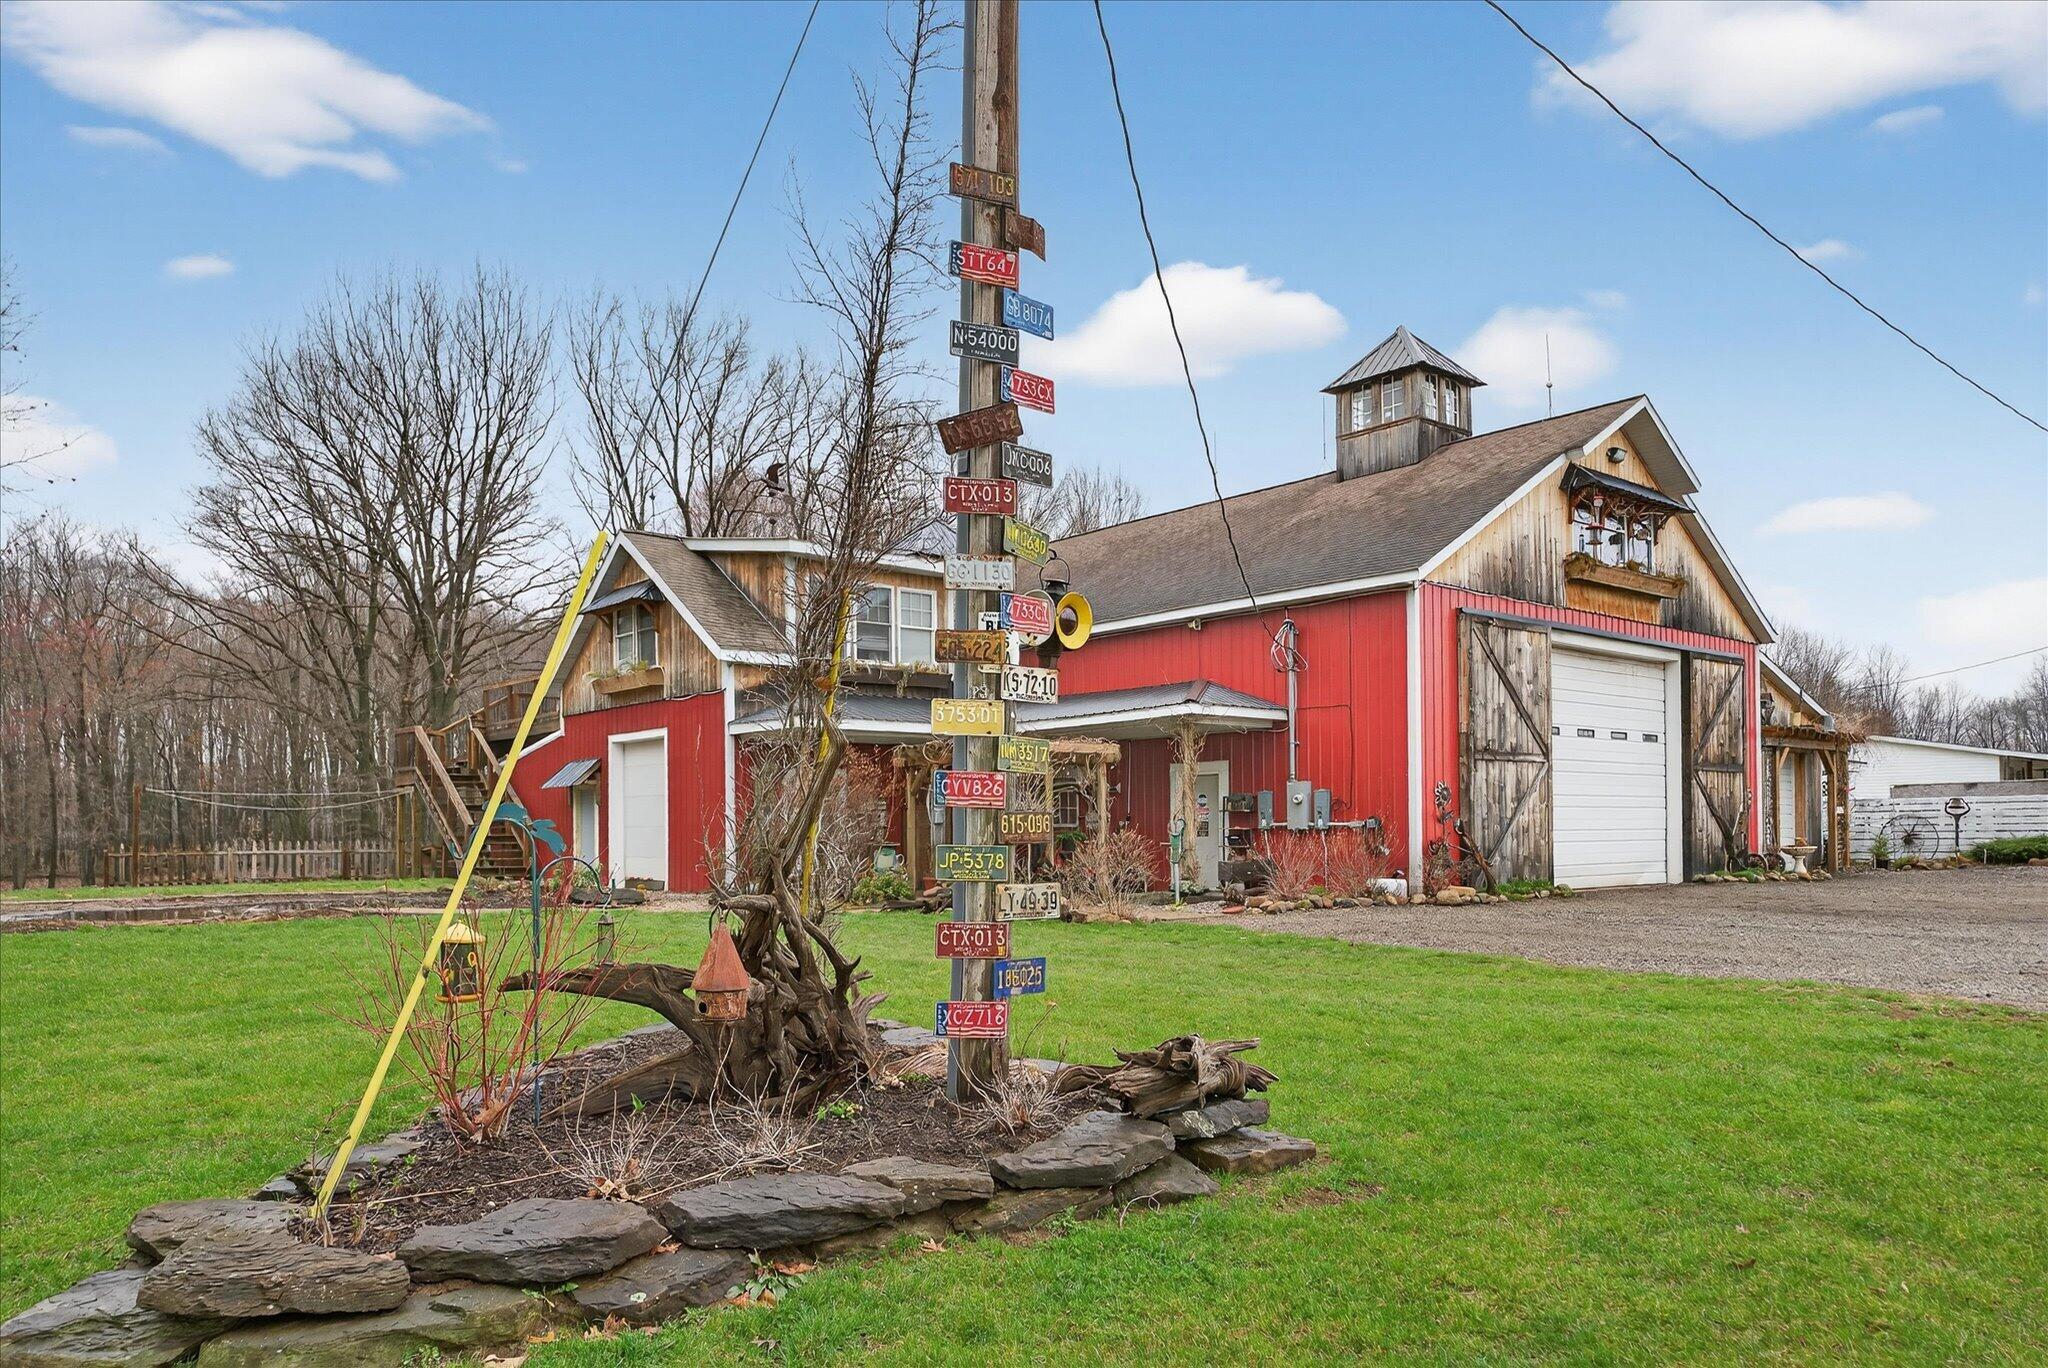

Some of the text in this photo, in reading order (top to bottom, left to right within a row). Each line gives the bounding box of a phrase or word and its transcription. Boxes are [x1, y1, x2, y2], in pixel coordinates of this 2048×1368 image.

[956, 249, 1016, 274] STT647
[941, 779, 1003, 796] CYV826
[943, 1008, 1004, 1026] XCZ716
